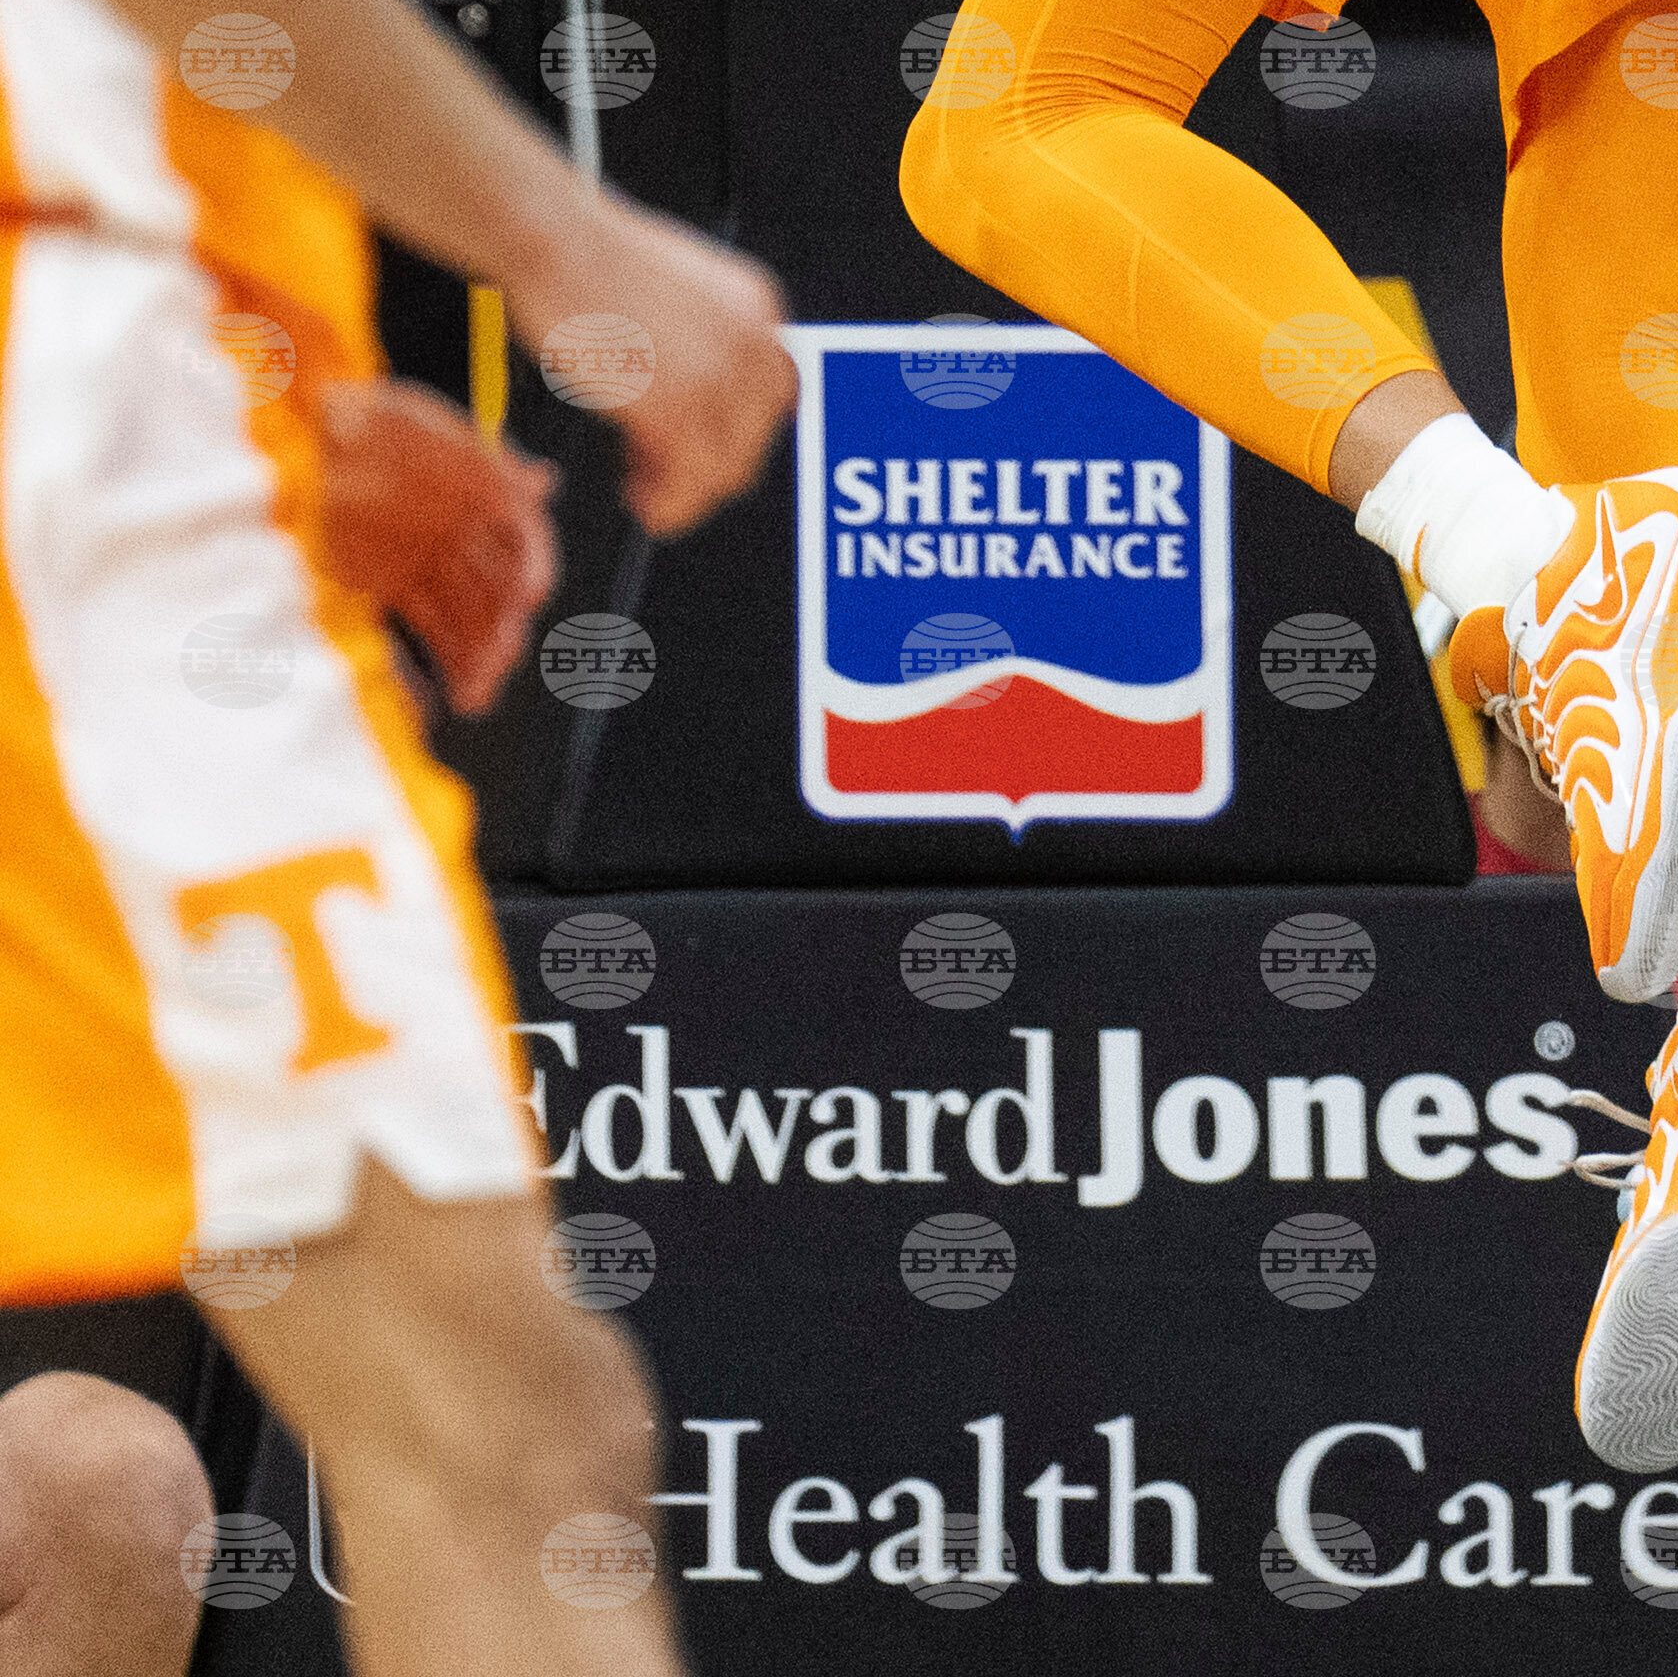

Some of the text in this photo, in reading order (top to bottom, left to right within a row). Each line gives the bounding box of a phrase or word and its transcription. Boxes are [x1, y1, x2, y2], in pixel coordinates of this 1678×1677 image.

[833, 457, 1190, 527] SHELTER
[835, 532, 1189, 580] INSURANCE
[649, 1413, 1214, 1586] Health
